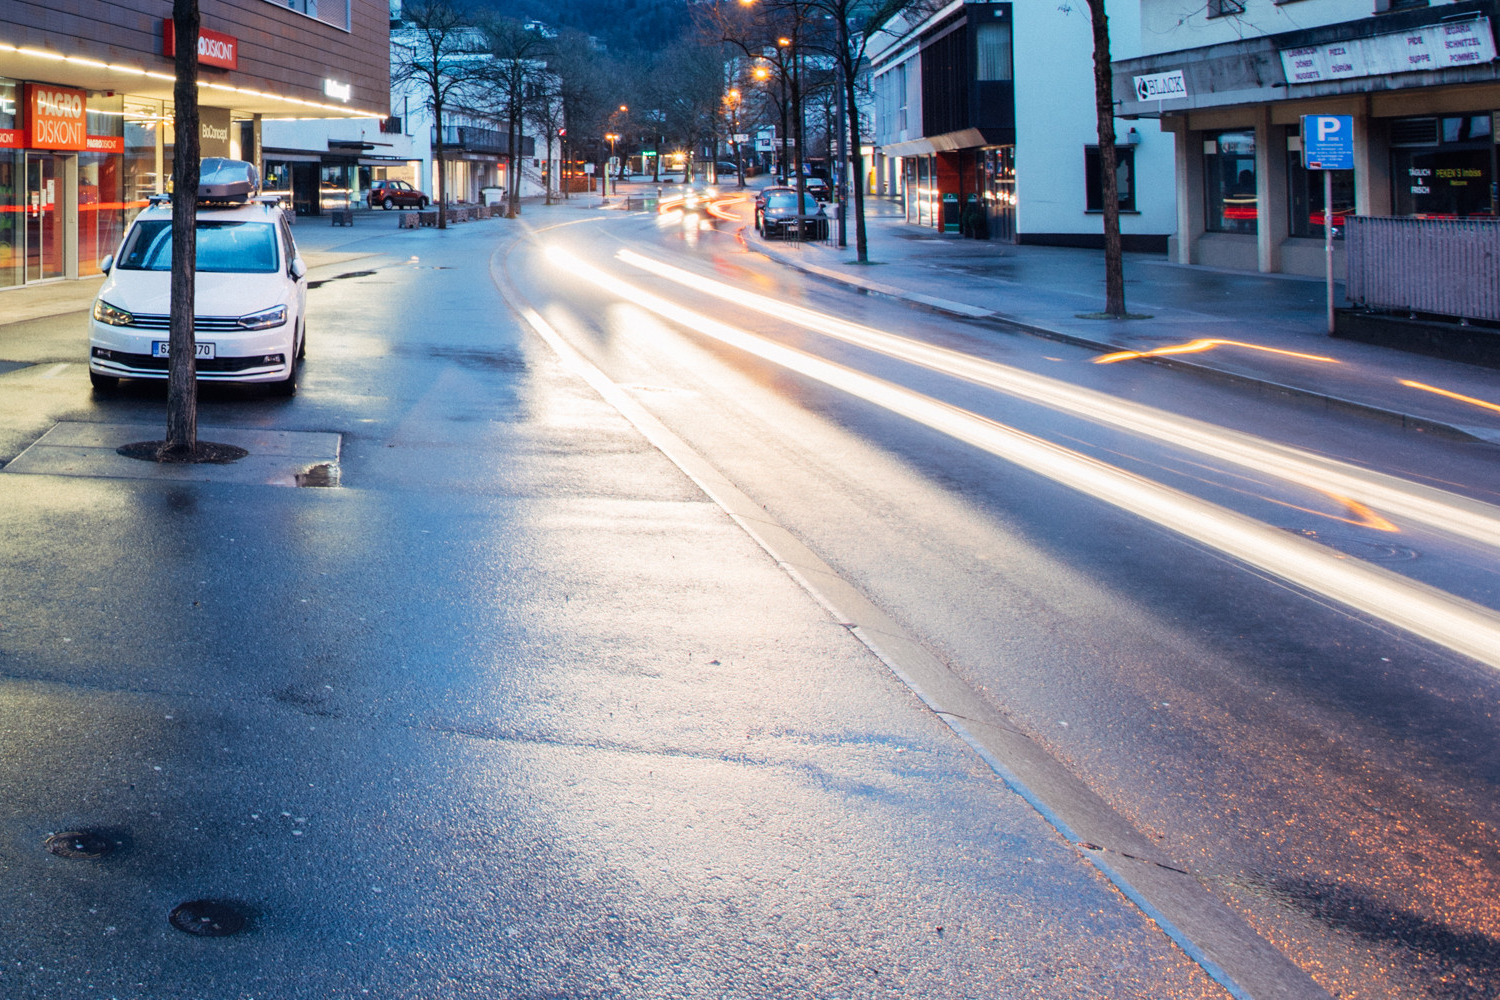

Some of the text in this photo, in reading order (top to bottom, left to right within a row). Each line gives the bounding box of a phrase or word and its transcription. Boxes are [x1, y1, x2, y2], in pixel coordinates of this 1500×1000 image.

[197, 36, 233, 60] ODISKONT
[1444, 37, 1481, 49] SCHNITZEL
[1328, 47, 1346, 56] PIZZA
[1449, 51, 1480, 62] POMMES
[1295, 59, 1313, 68] DÖNER
[1408, 53, 1431, 64] SUPPE
[1295, 71, 1320, 80] NUGGETS
[1147, 76, 1184, 95] BLACK
[37, 90, 82, 119] PAGRO
[37, 119, 82, 145] DISKONT
[202, 123, 228, 143] BoConcept
[1317, 117, 1341, 141] P
[1410, 186, 1430, 194] FRISCH
